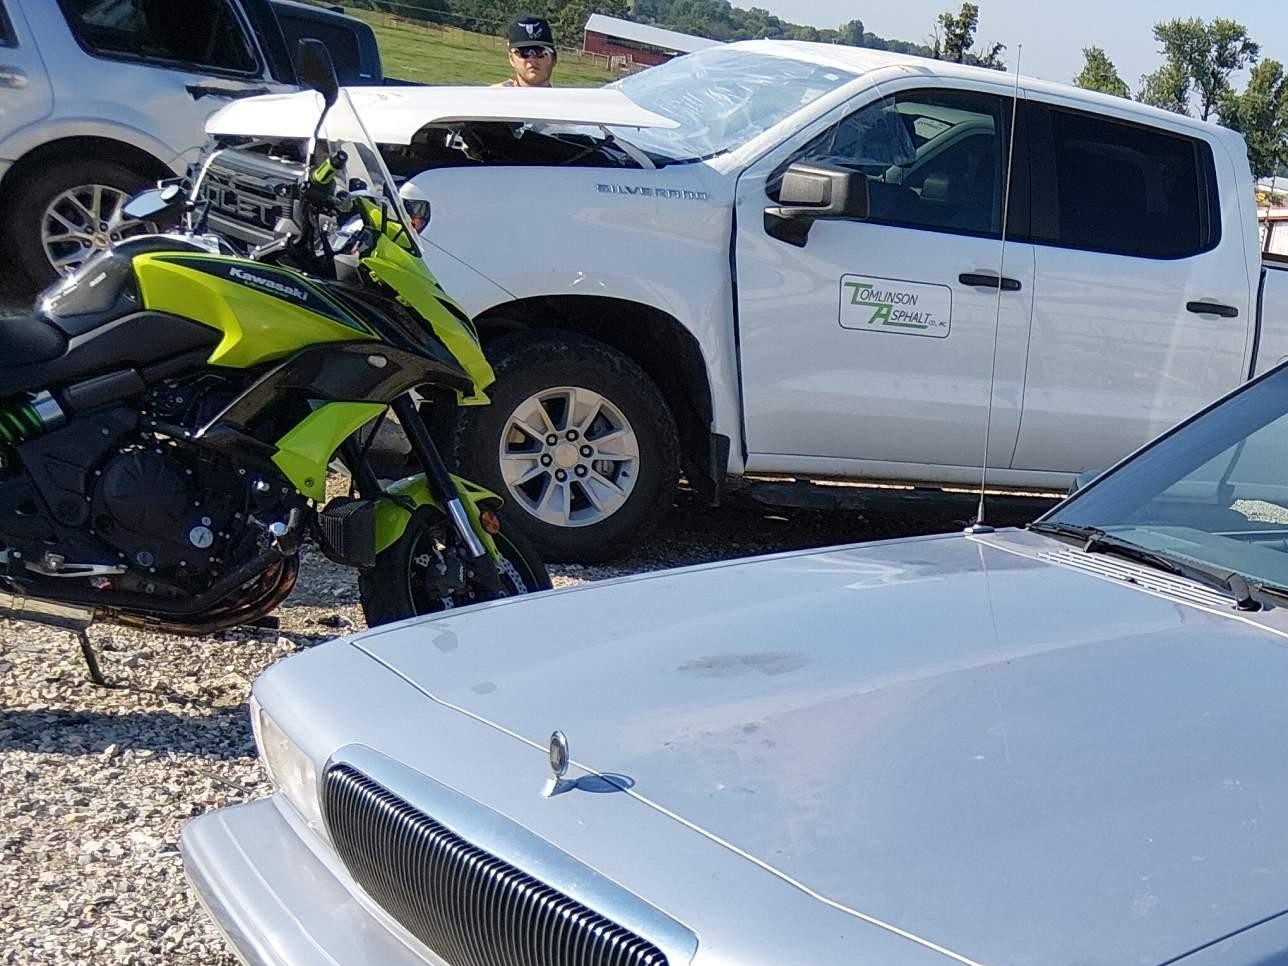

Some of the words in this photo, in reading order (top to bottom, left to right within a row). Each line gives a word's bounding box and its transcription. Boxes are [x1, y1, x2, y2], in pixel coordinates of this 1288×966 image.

[595, 184, 710, 200] SILVERADO
[229, 266, 309, 301] Kawasaki
[844, 281, 918, 306] TOMLINSON
[868, 304, 932, 327] ASPHALT
